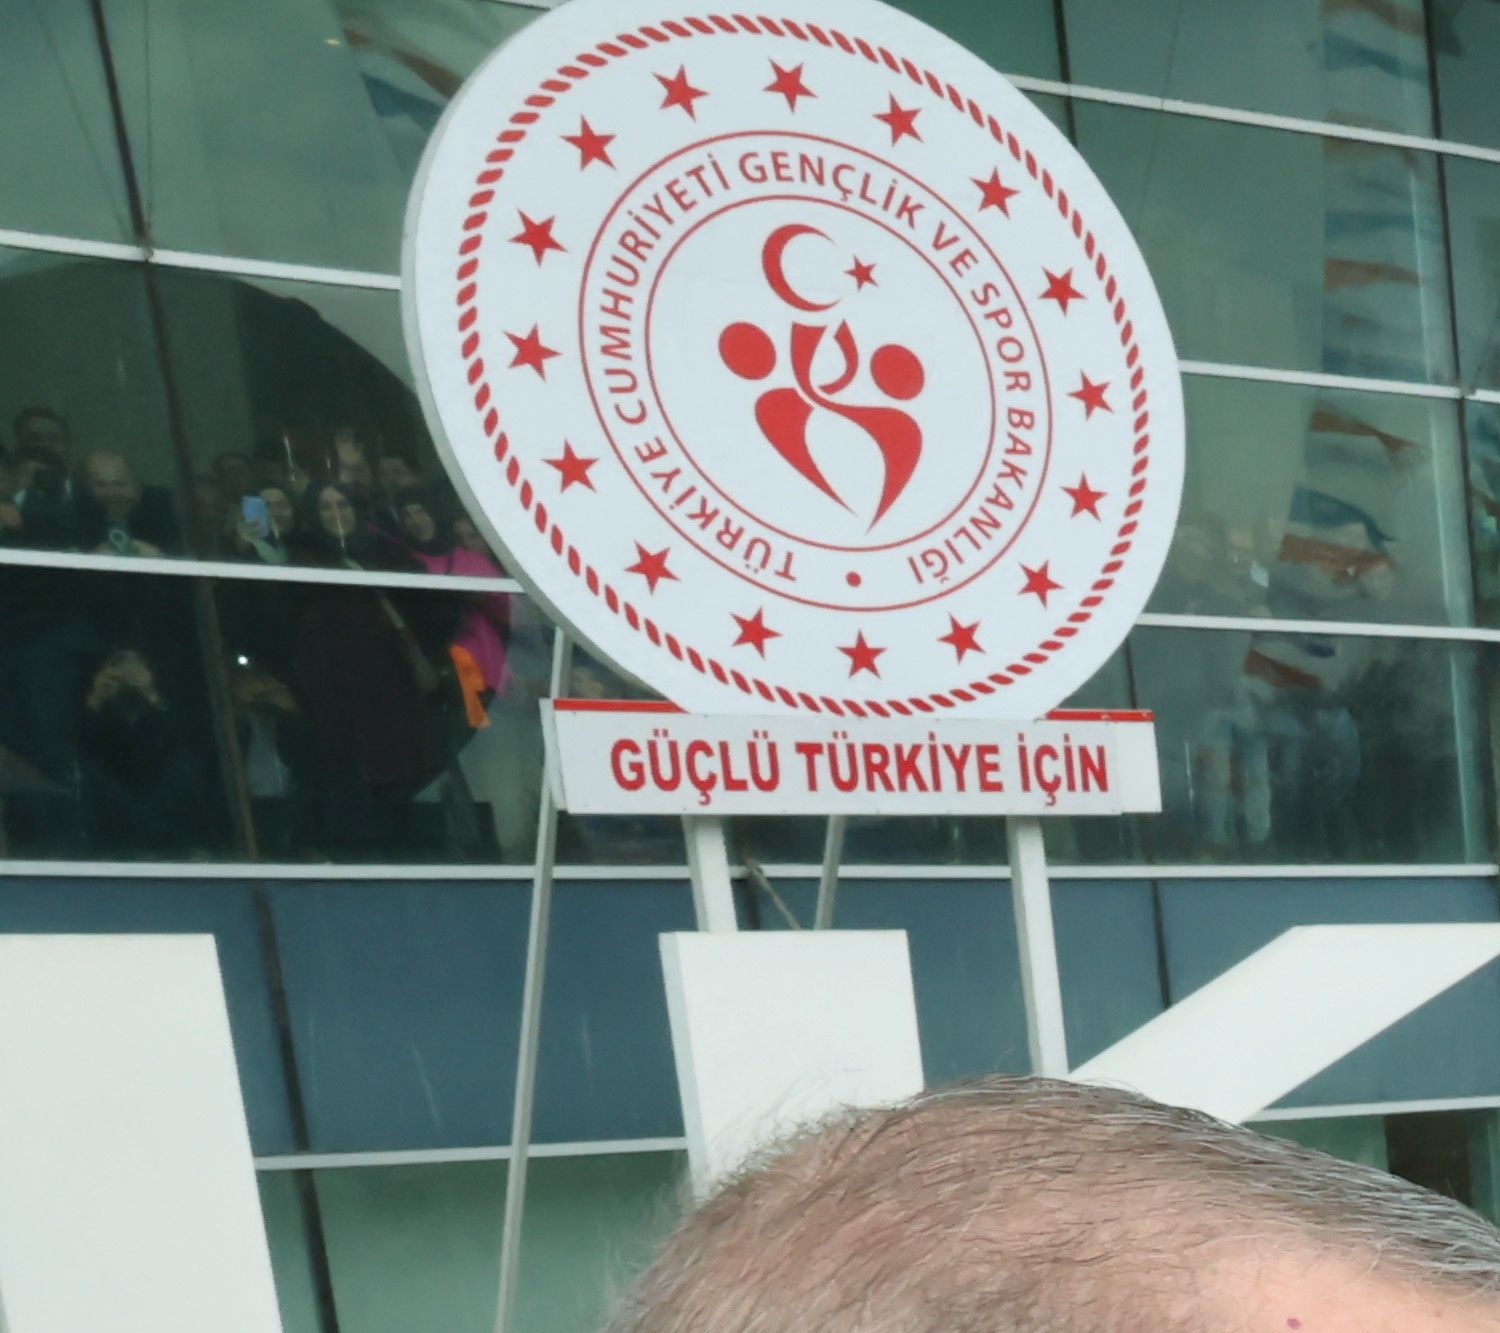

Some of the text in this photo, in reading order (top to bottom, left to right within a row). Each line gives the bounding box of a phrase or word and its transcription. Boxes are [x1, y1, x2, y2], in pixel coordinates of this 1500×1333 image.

[600, 151, 1034, 585] TÜRKİYE CUMHURİYETİ GENÇLİK VE SPOR BAKANLIĞI
[610, 729, 1109, 805] GÜÇLÜ TÜRKİYE İÇİN
